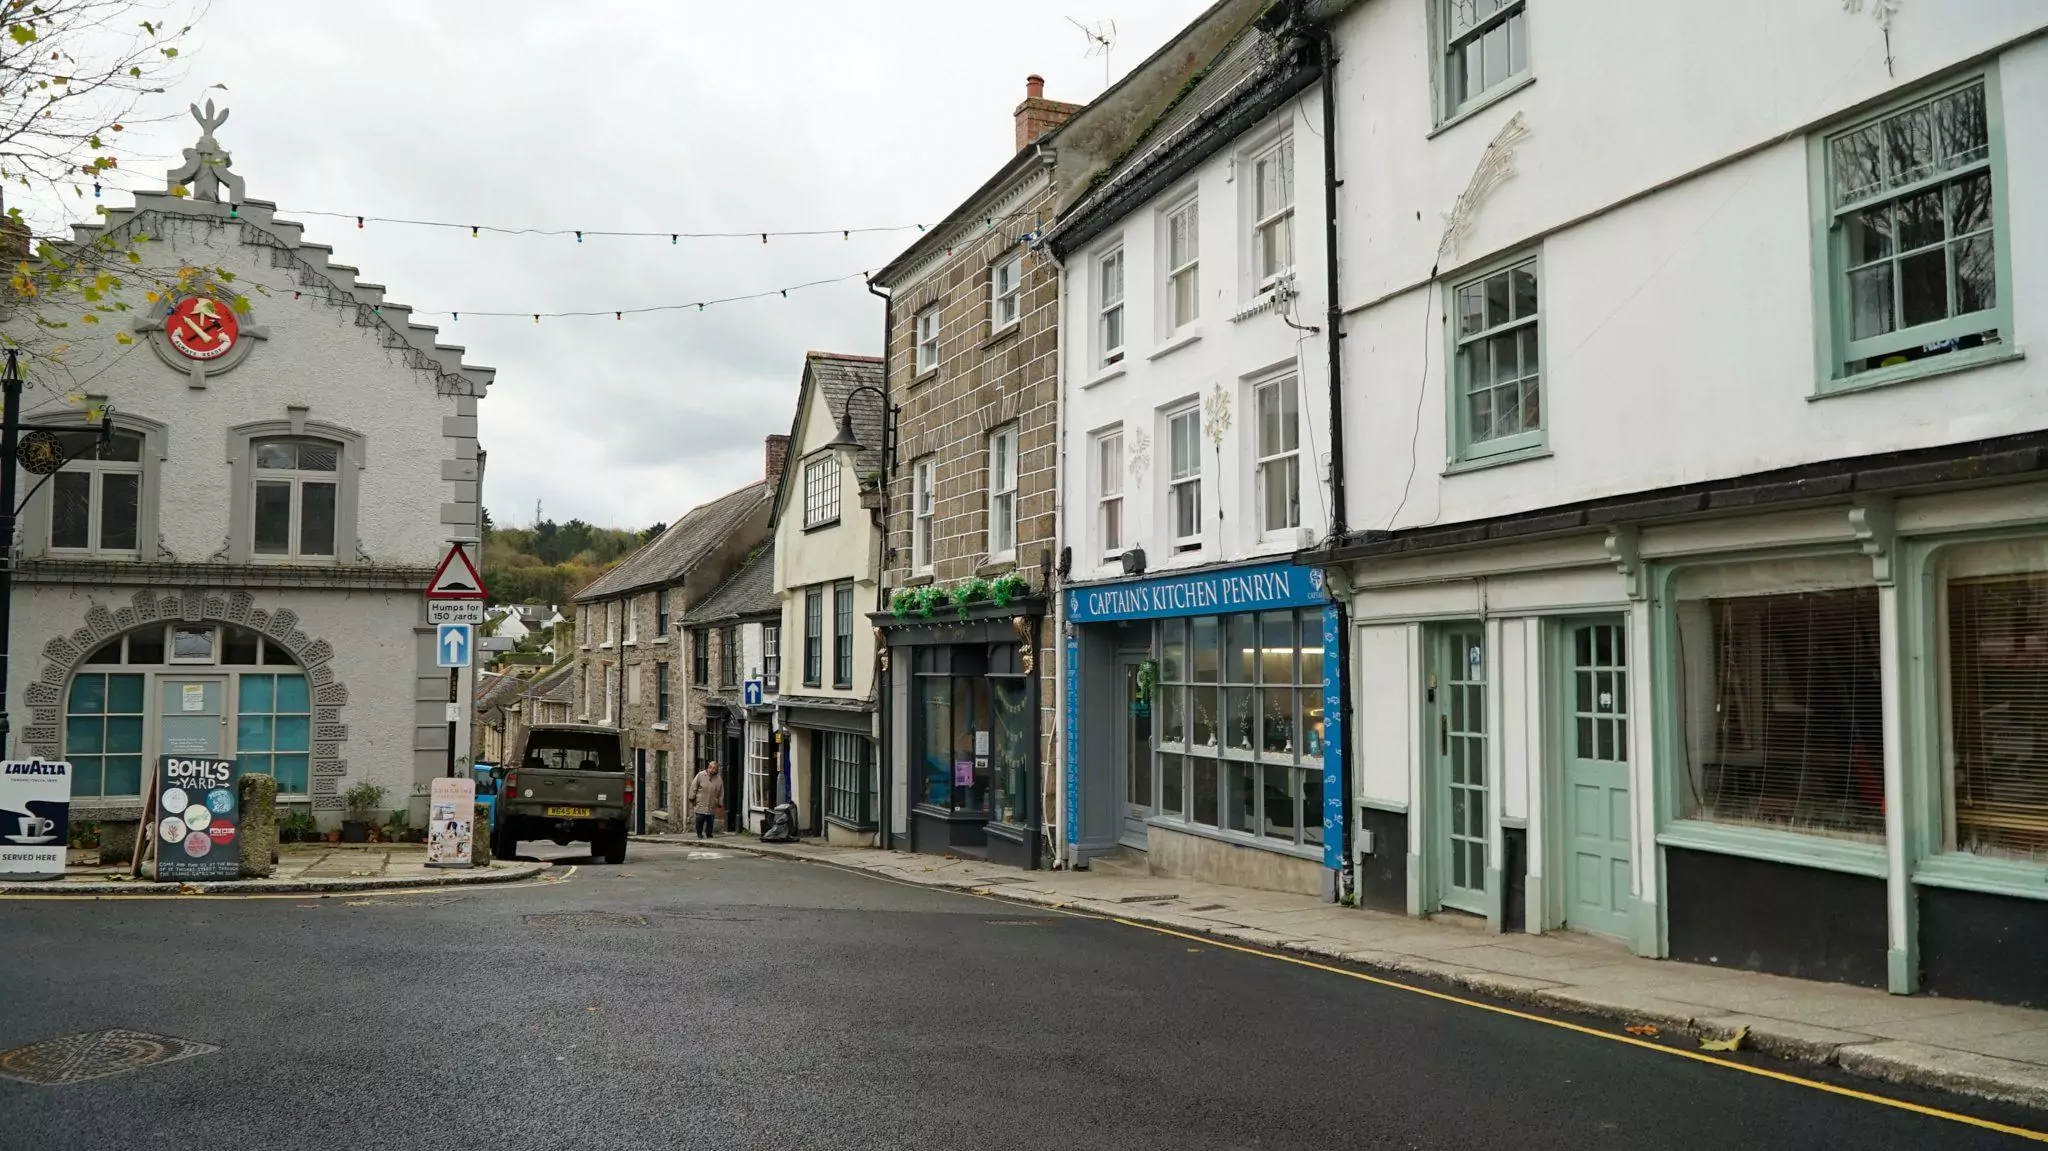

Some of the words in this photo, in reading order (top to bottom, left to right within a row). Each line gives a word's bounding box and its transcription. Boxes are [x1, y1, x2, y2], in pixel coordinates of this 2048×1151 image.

[175, 340, 197, 356] ALWAYS
[202, 348, 222, 357] READY
[1089, 586, 1149, 615] CAPTAIN'S
[1153, 580, 1218, 610] KITCHEN
[1221, 571, 1291, 604] PENRYN
[432, 603, 464, 612] Humps
[434, 612, 450, 620] 150
[453, 613, 478, 621] yards
[5, 760, 66, 776] LAVAZZA
[167, 758, 230, 781] BOHL'S
[180, 777, 216, 790] YARD
[2, 853, 34, 861] SERVED
